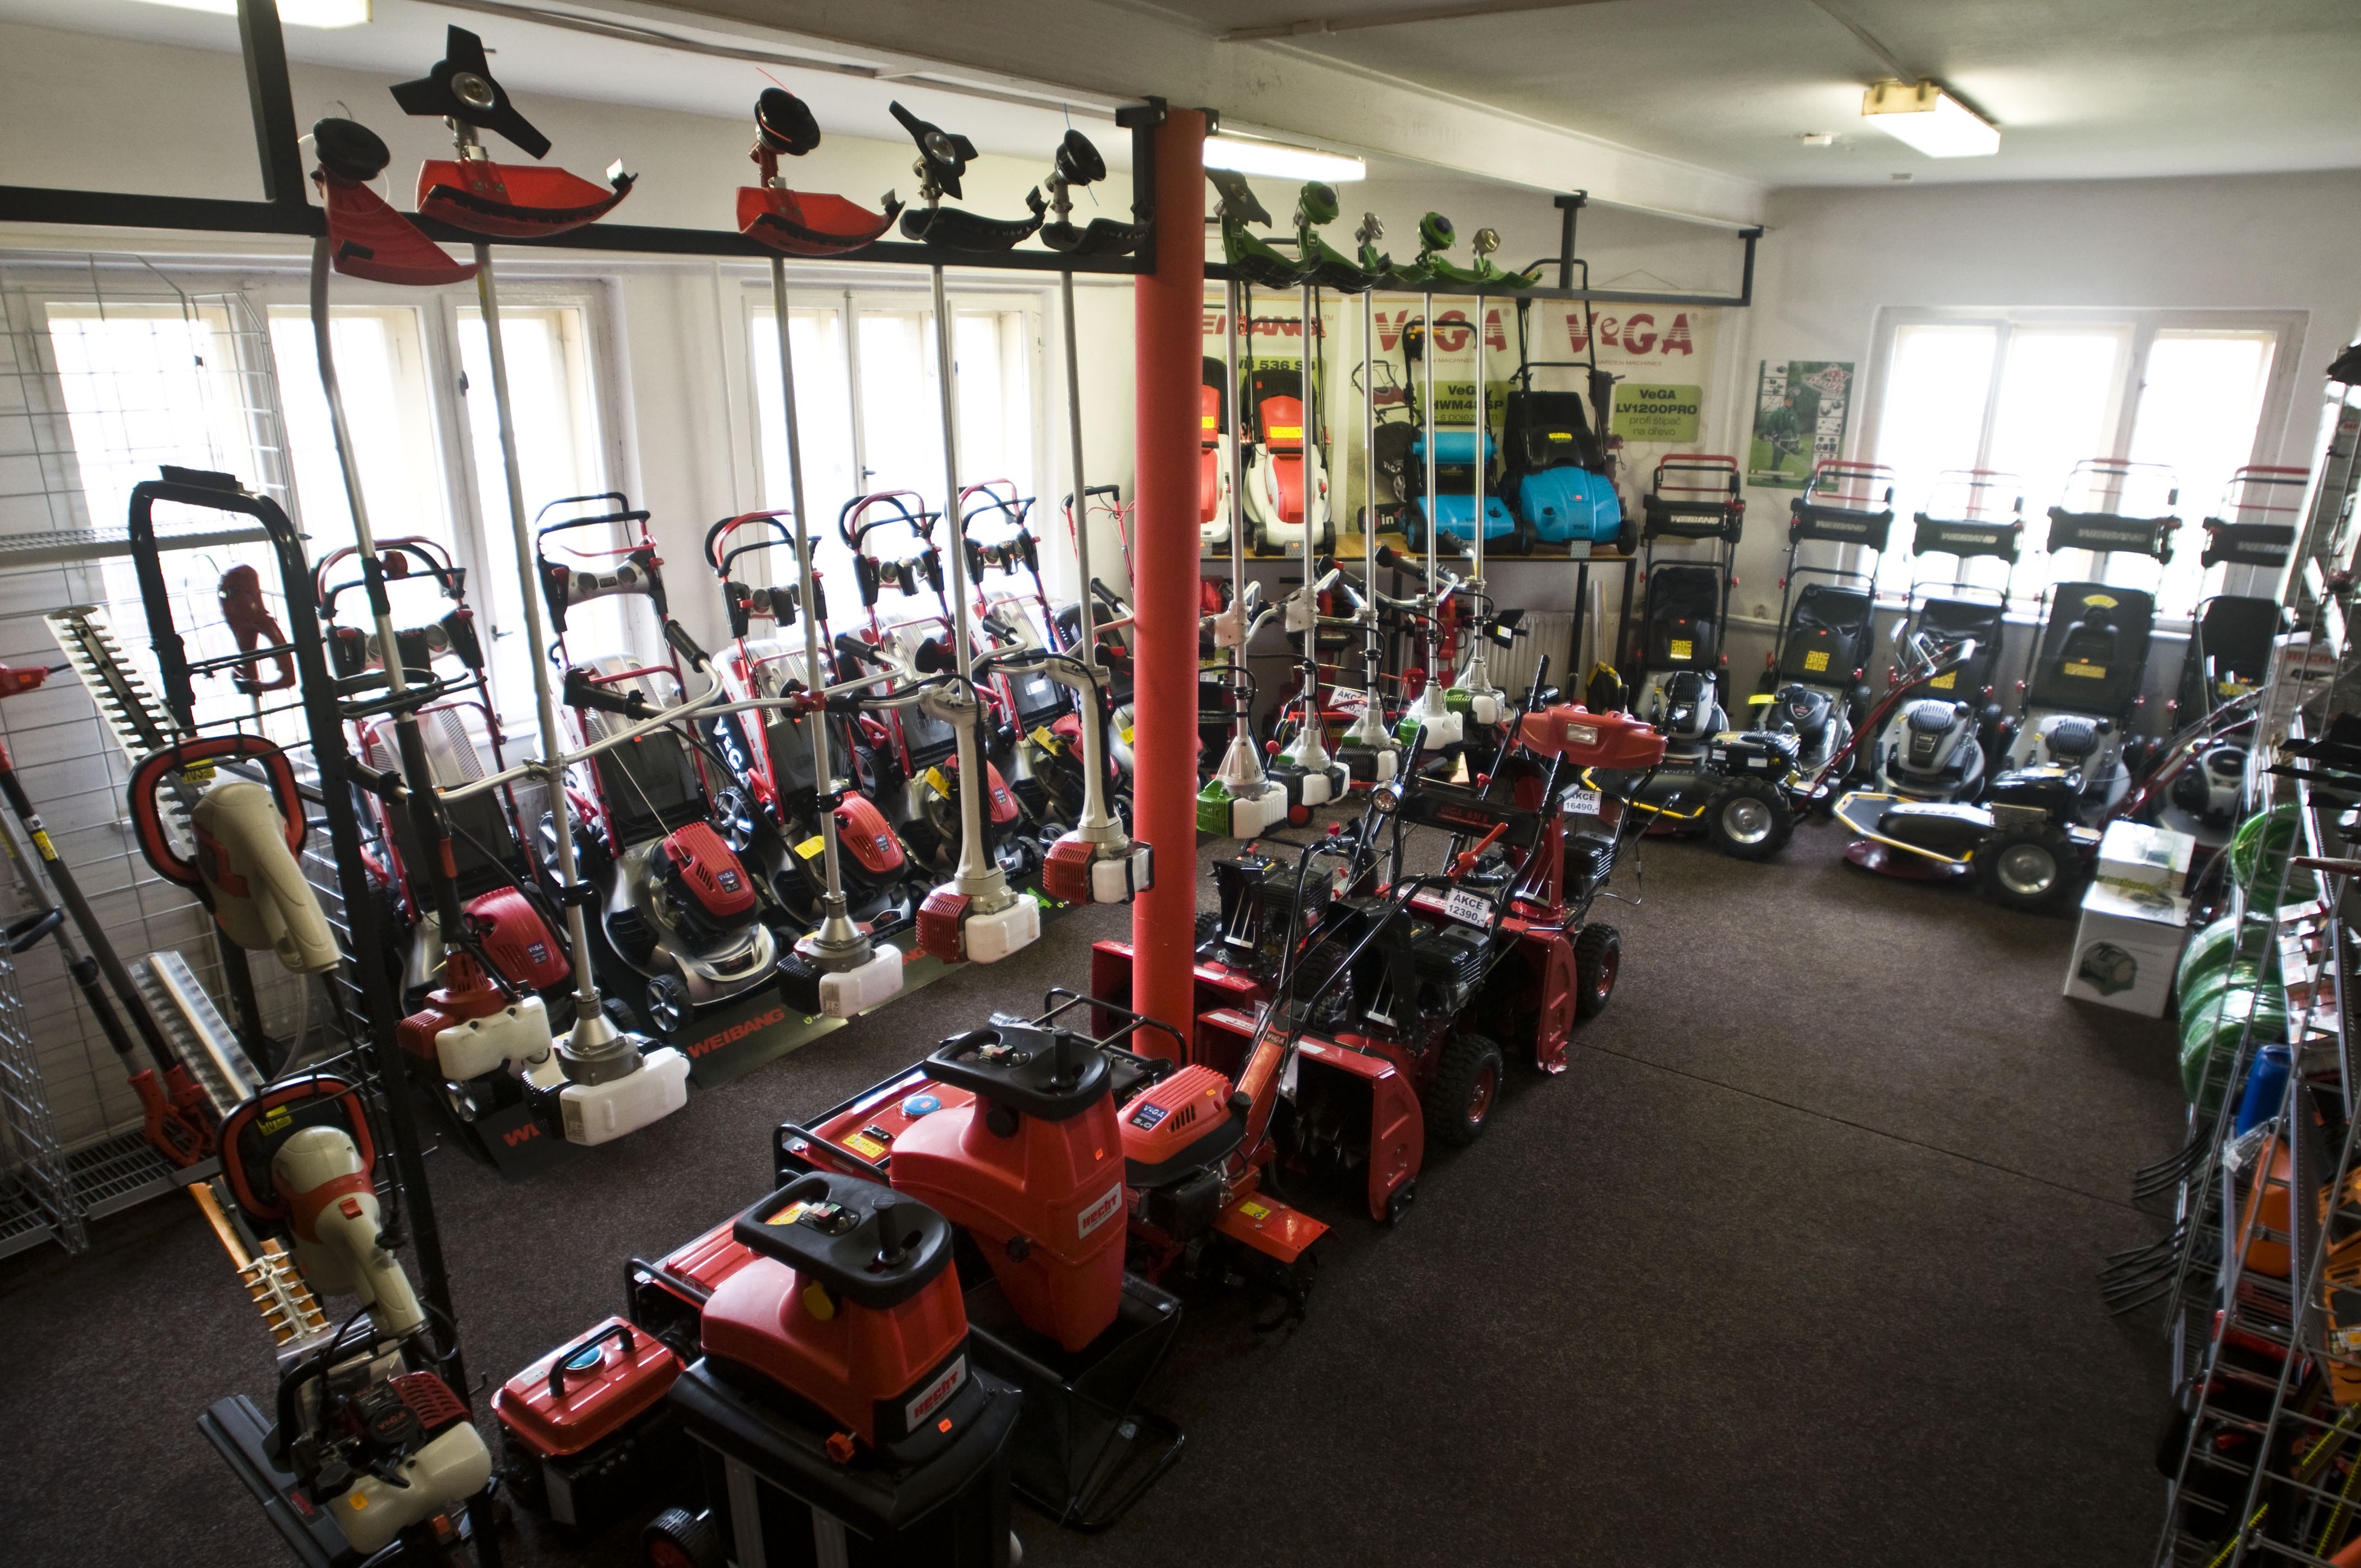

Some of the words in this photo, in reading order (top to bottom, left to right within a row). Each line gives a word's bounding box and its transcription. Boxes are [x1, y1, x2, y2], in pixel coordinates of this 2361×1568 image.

[1566, 312, 1693, 355] VeGA
[1259, 360, 1289, 370] 536
[1448, 386, 1476, 395] VeG
[1640, 389, 1676, 400] VeGA
[1616, 404, 1697, 415] LV1200PRO
[1572, 792, 1595, 801] KCE
[1566, 802, 1598, 812] 16490,-
[1454, 894, 1484, 911] AKCE
[1449, 904, 1484, 924] 12390,-
[687, 1008, 785, 1058] WEIBANG
